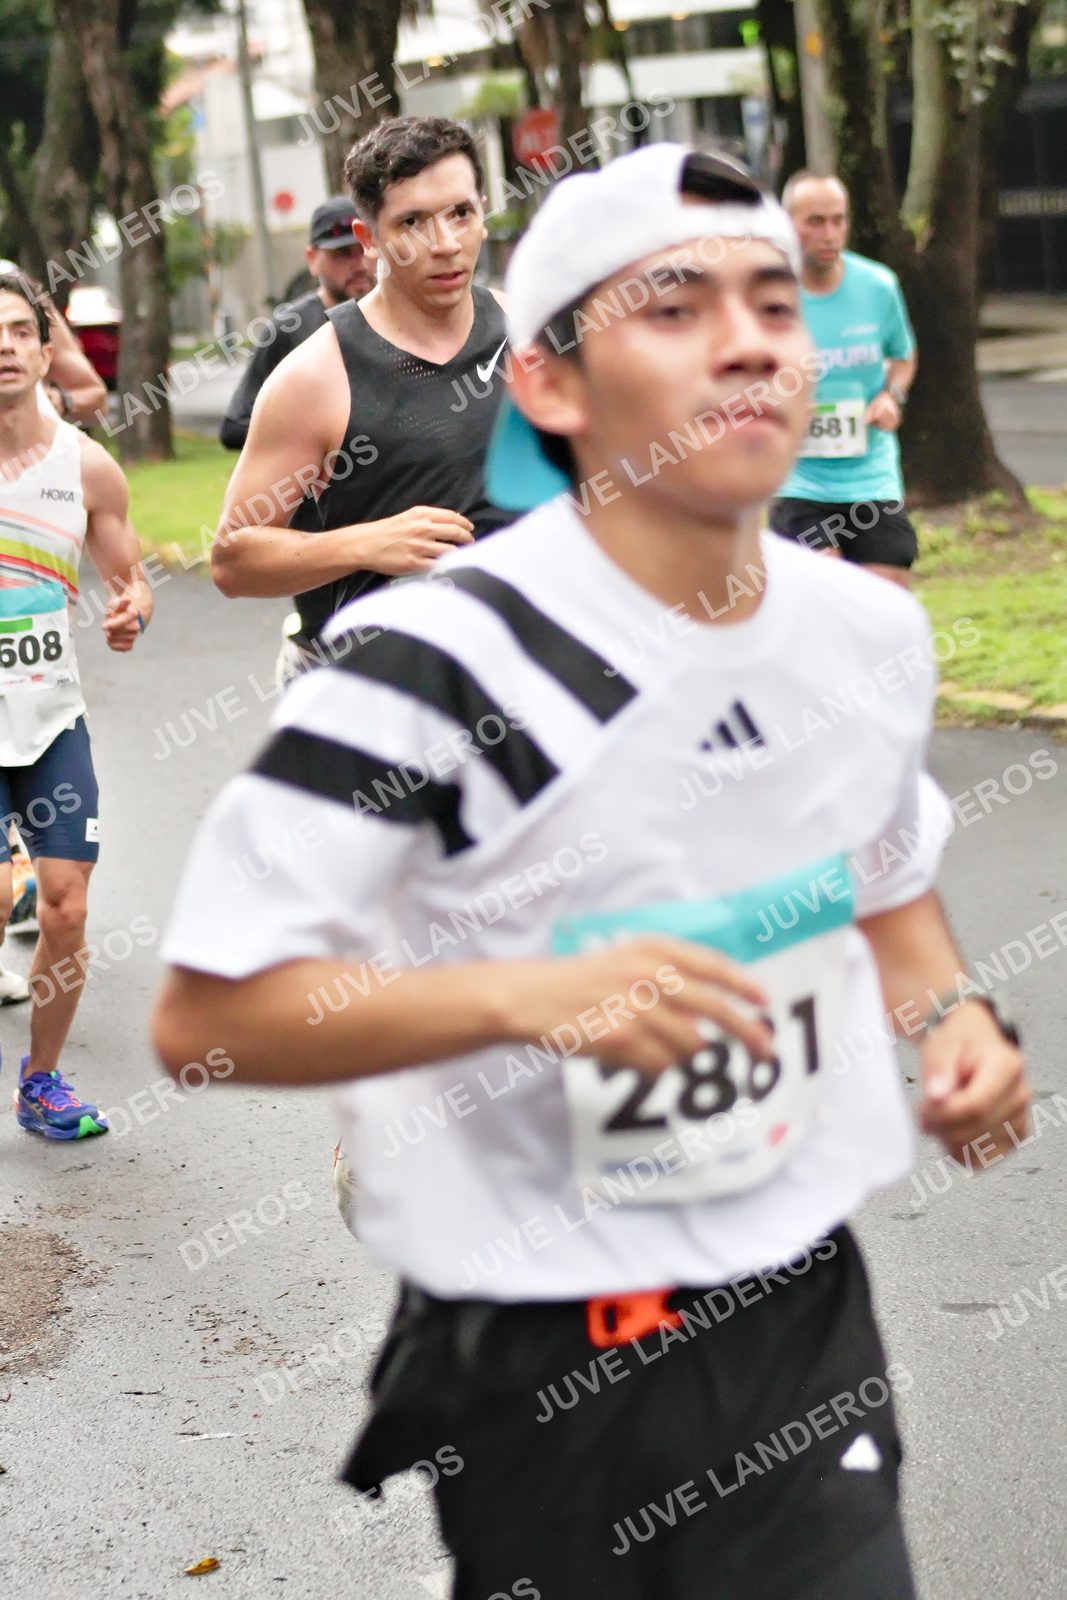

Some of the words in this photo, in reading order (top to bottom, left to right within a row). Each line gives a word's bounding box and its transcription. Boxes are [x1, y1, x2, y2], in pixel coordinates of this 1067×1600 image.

[809, 416, 856, 438] 681
[41, 488, 75, 502] HOKA
[0, 630, 63, 668] 608
